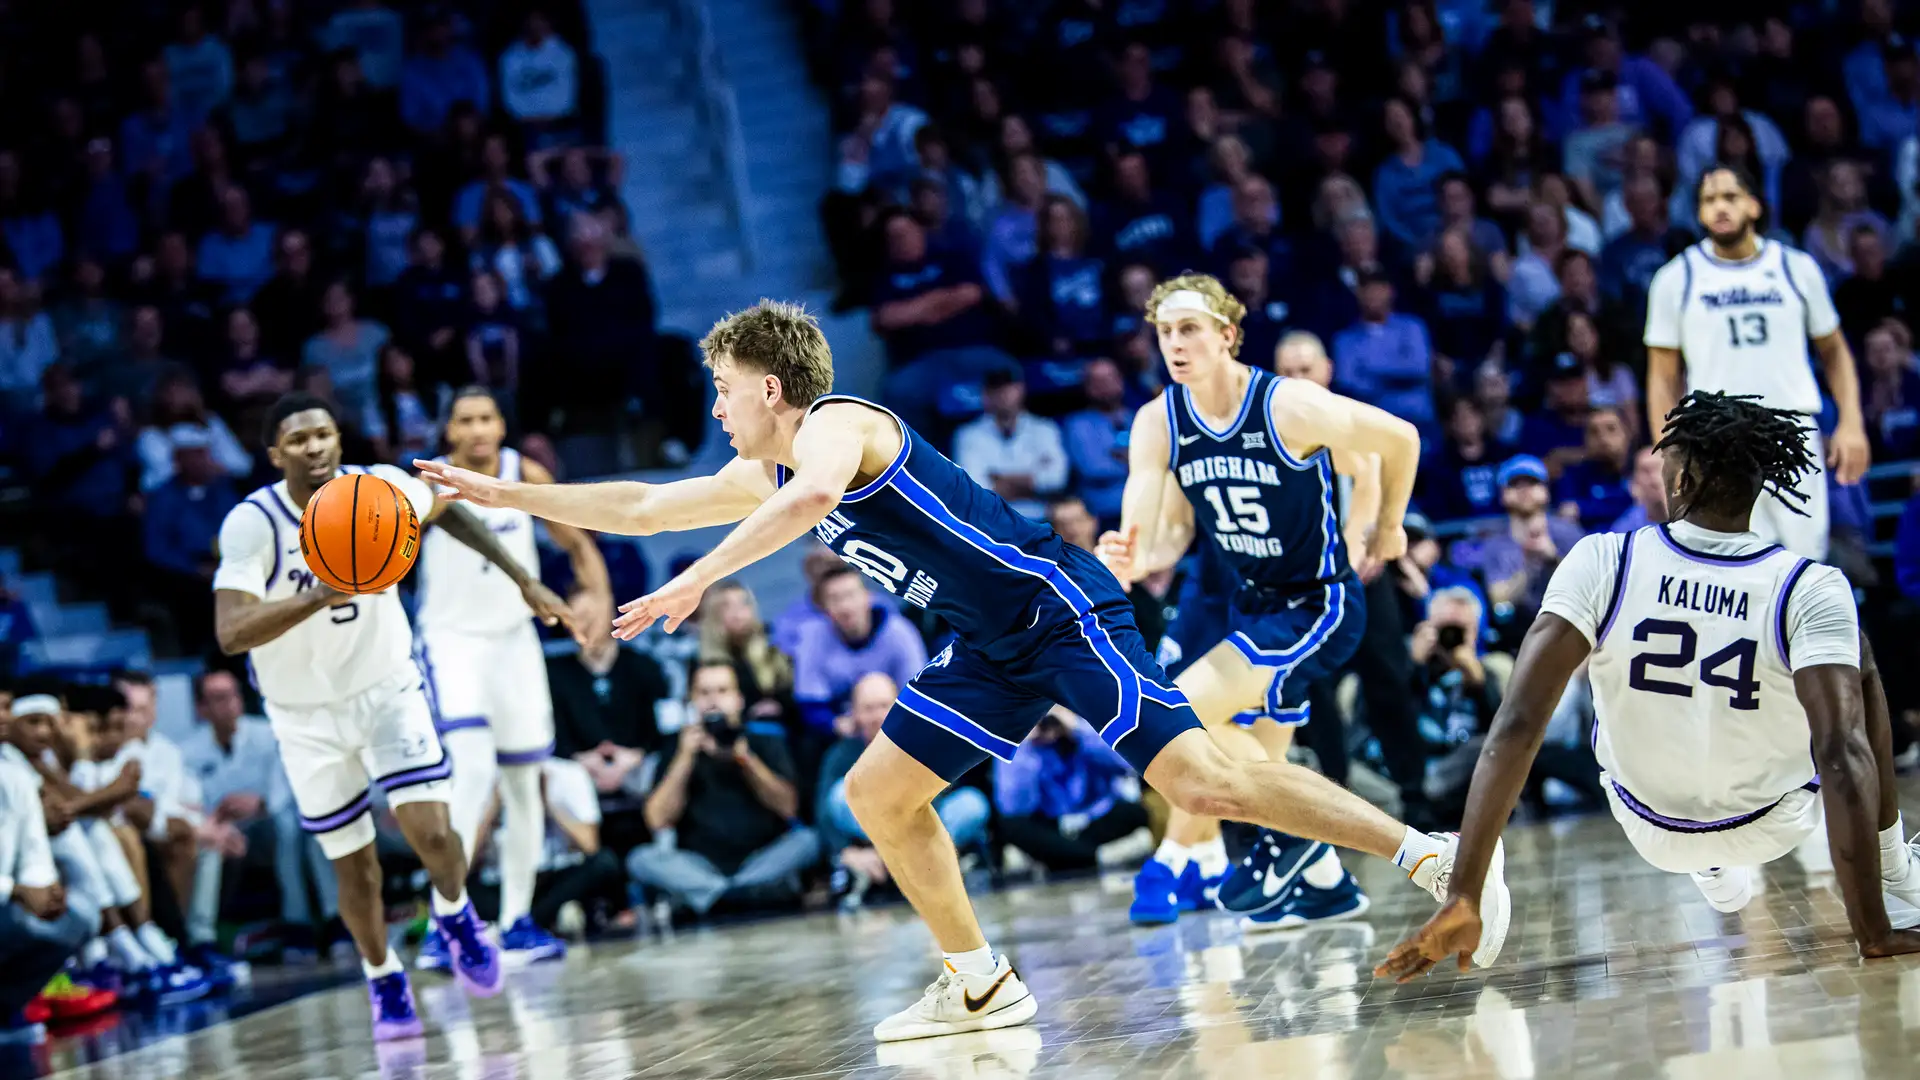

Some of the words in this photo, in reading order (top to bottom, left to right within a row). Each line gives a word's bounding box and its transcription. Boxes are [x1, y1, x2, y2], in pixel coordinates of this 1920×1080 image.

[1728, 312, 1768, 347] 13
[1178, 455, 1282, 488] BRIGHAM
[1203, 485, 1270, 535] 15
[1214, 532, 1284, 558] YOUNG
[1657, 574, 1749, 621] KALUMA
[1628, 617, 1761, 711] 24
